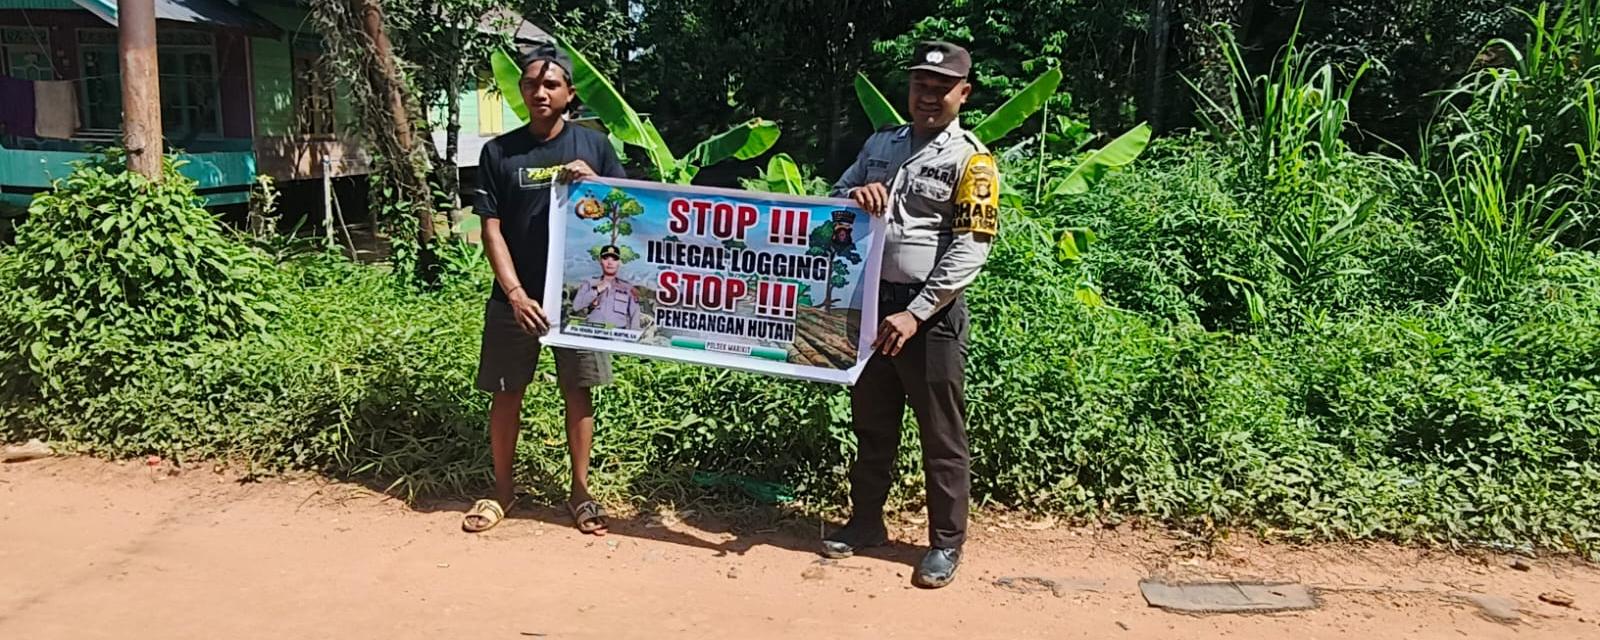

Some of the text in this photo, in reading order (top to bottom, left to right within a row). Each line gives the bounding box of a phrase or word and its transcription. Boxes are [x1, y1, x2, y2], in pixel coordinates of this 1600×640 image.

[669, 199, 809, 245] STOP !!!
[647, 240, 828, 281] ILLEGAL LOGGING
[658, 271, 796, 316] STOP !!!
[656, 309, 794, 341] PENEBANGAN HUTAN
